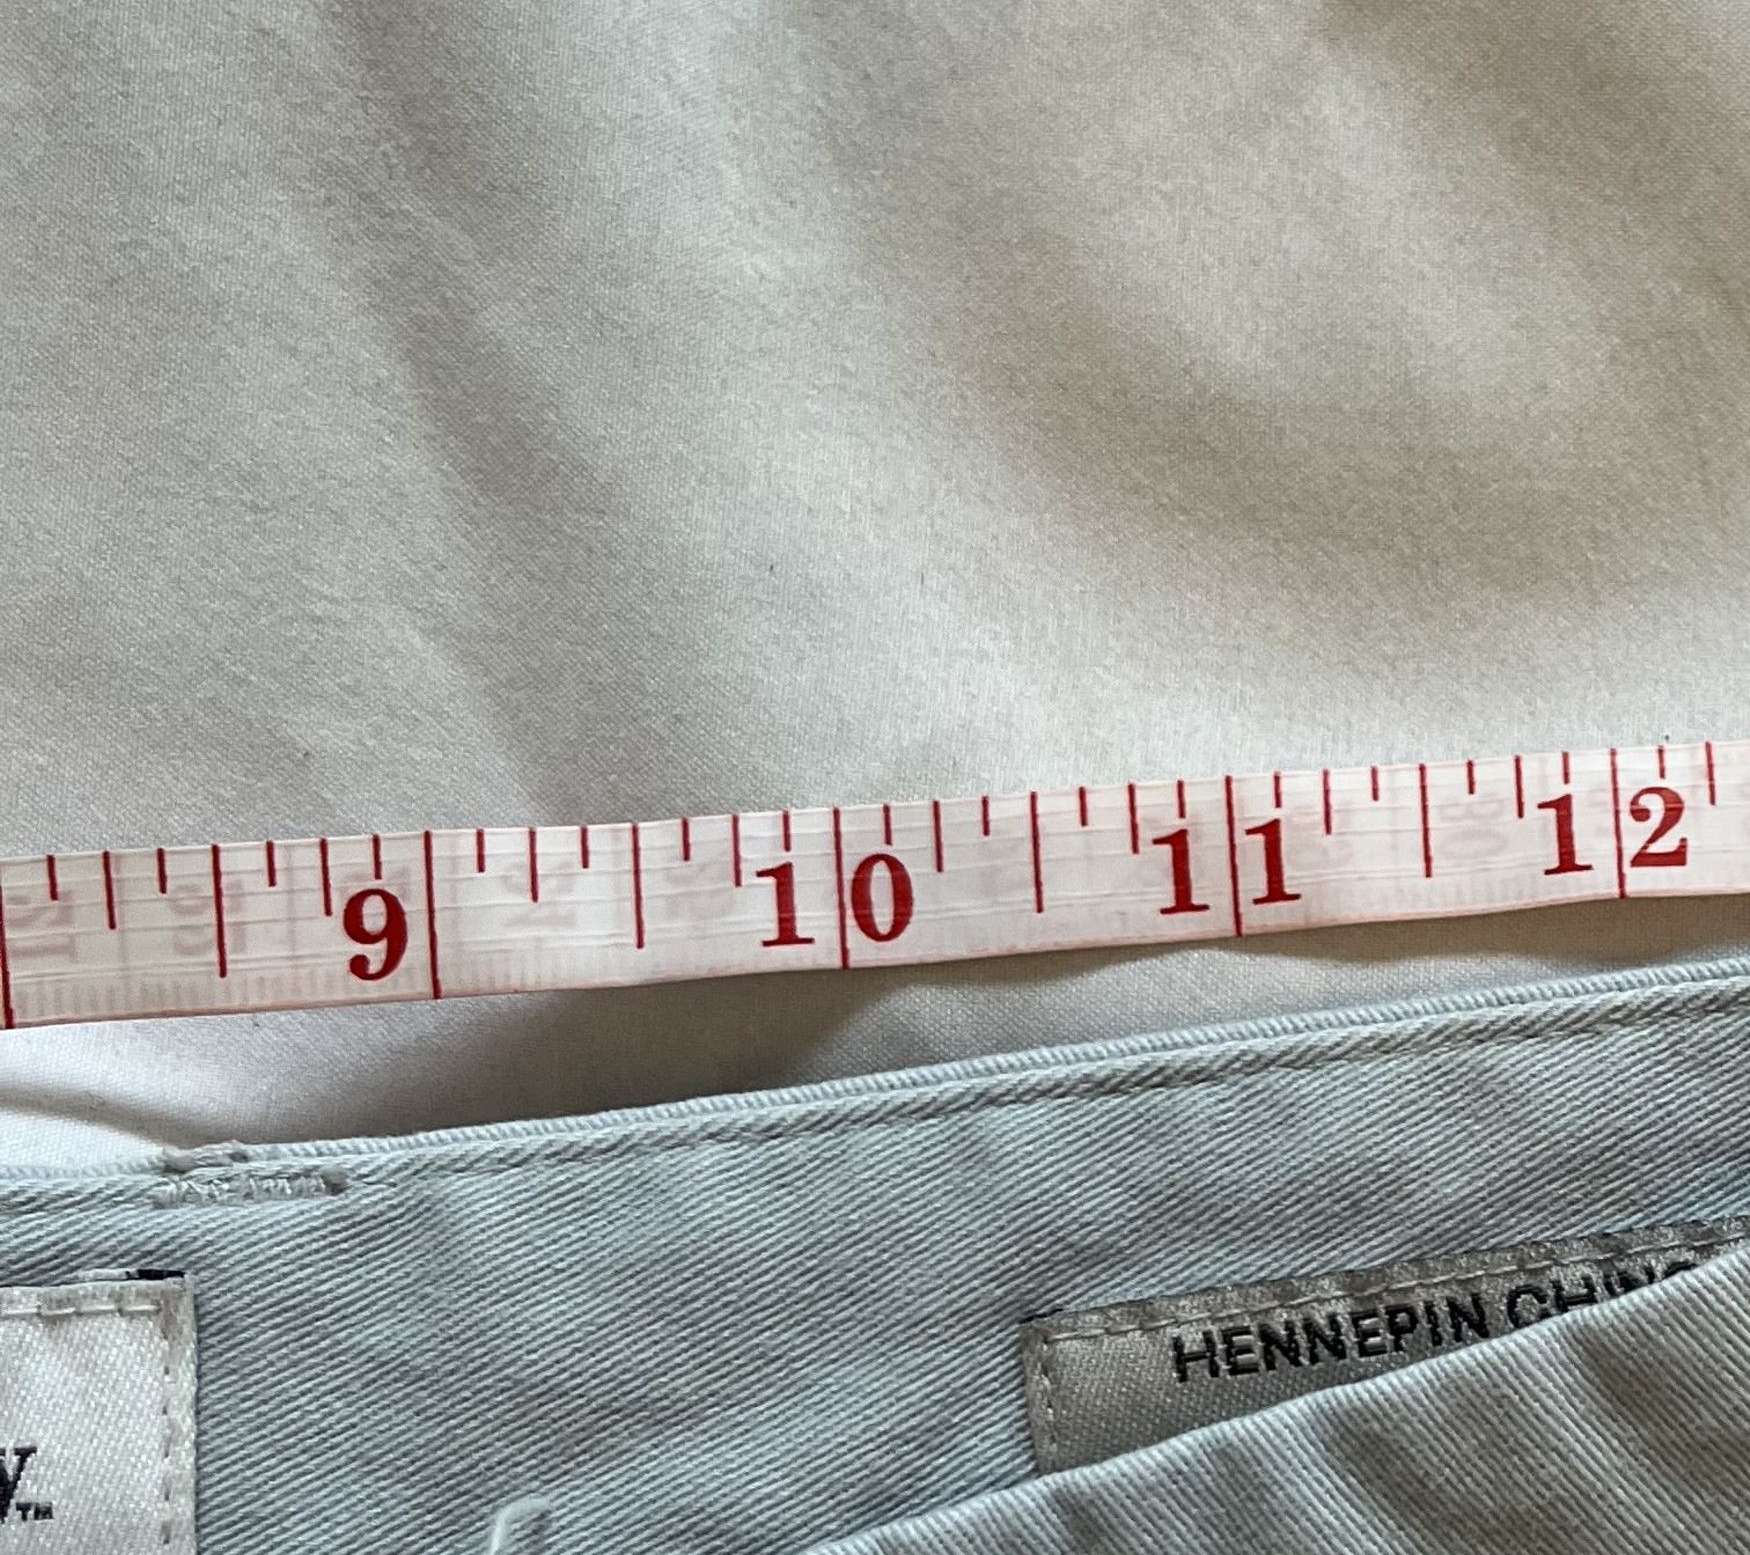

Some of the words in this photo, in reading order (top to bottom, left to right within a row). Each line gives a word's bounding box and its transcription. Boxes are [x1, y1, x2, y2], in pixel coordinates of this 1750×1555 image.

[342, 887, 409, 980] 9
[755, 853, 913, 946] 10
[1151, 818, 1301, 914] 11
[1538, 785, 1689, 875] 12
[1172, 1293, 1490, 1382] HENNEPIN
